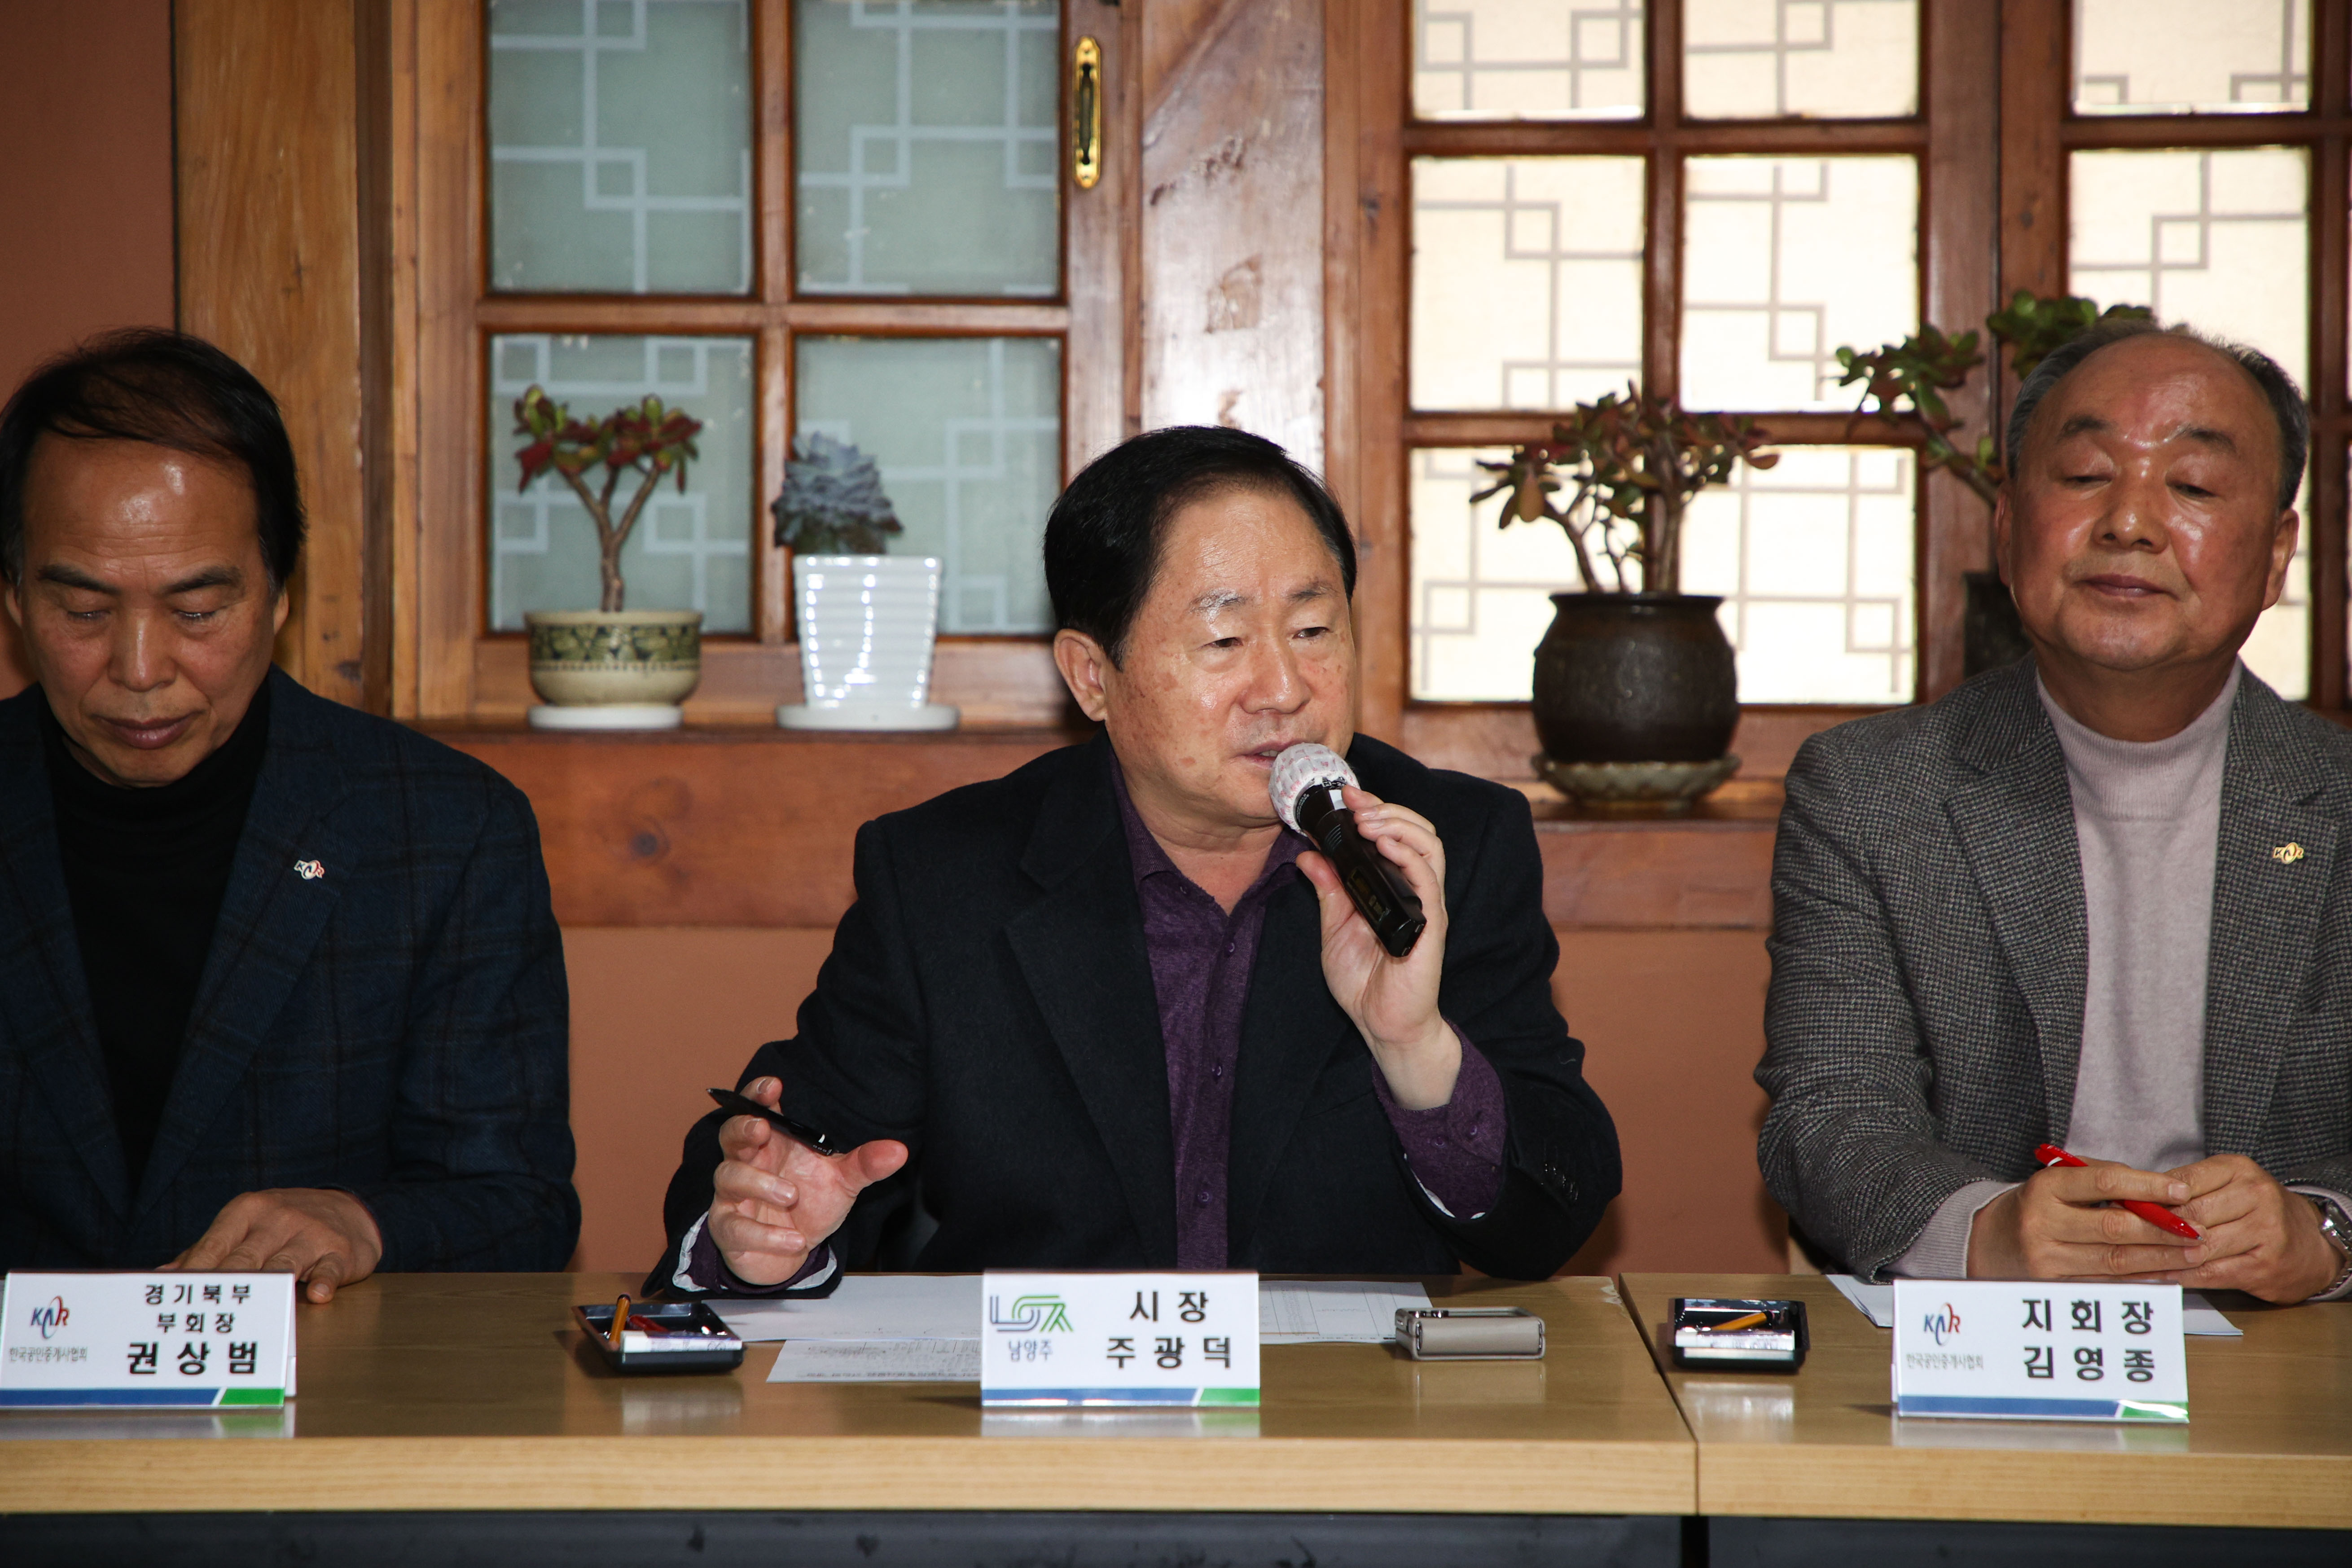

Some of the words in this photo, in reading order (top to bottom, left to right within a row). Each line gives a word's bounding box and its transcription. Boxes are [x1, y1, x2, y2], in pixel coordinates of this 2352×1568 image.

[145, 1284, 250, 1305] 경기북부
[1130, 1291, 1209, 1322] 시장
[157, 1313, 235, 1333] 부회장
[2022, 1299, 2154, 1335] 지회장
[9, 1347, 88, 1362] 한국공인중개사협회
[127, 1342, 258, 1375] 권상범
[1009, 1340, 1053, 1362] 남양주
[1107, 1337, 1230, 1369] 주광덕
[2024, 1347, 2155, 1382] 김영종
